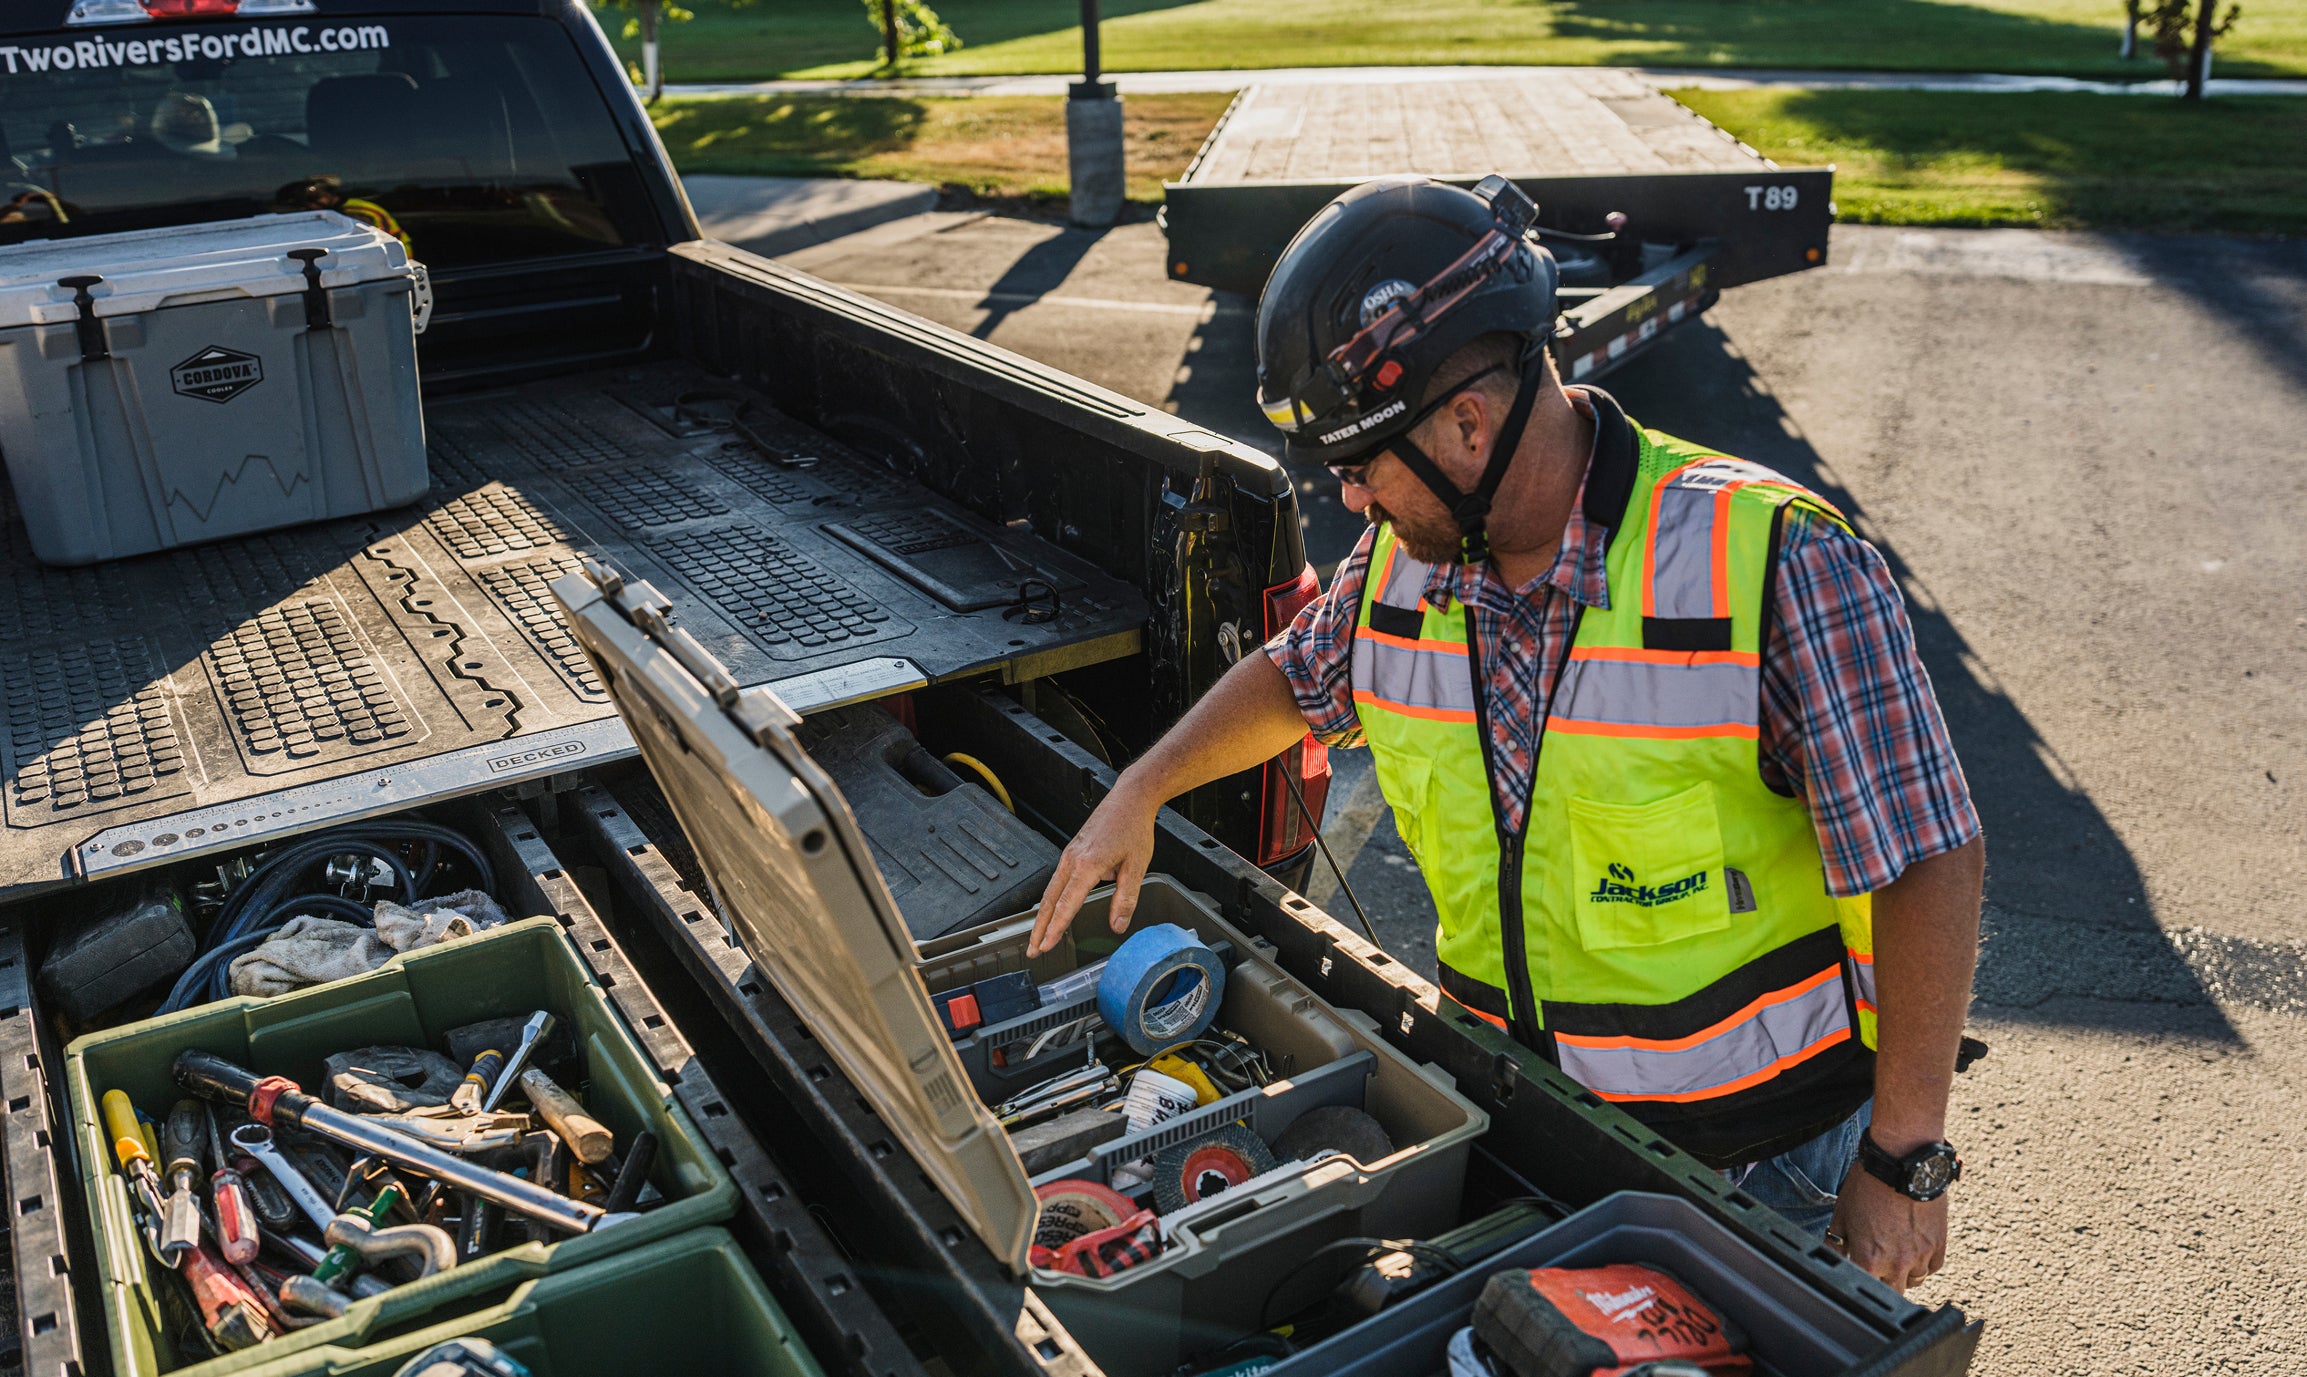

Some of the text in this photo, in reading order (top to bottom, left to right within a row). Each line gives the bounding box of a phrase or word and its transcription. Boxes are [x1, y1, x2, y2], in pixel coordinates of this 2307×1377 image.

[0, 25, 389, 73] TwoRiversFordMC.com
[1744, 185, 1798, 211] T89
[1363, 281, 1404, 309] OSHA
[183, 363, 252, 385] CORDOVA
[1319, 400, 1407, 445] TATER MOON
[495, 744, 578, 768] DECKED
[1590, 871, 1707, 900] Jackson
